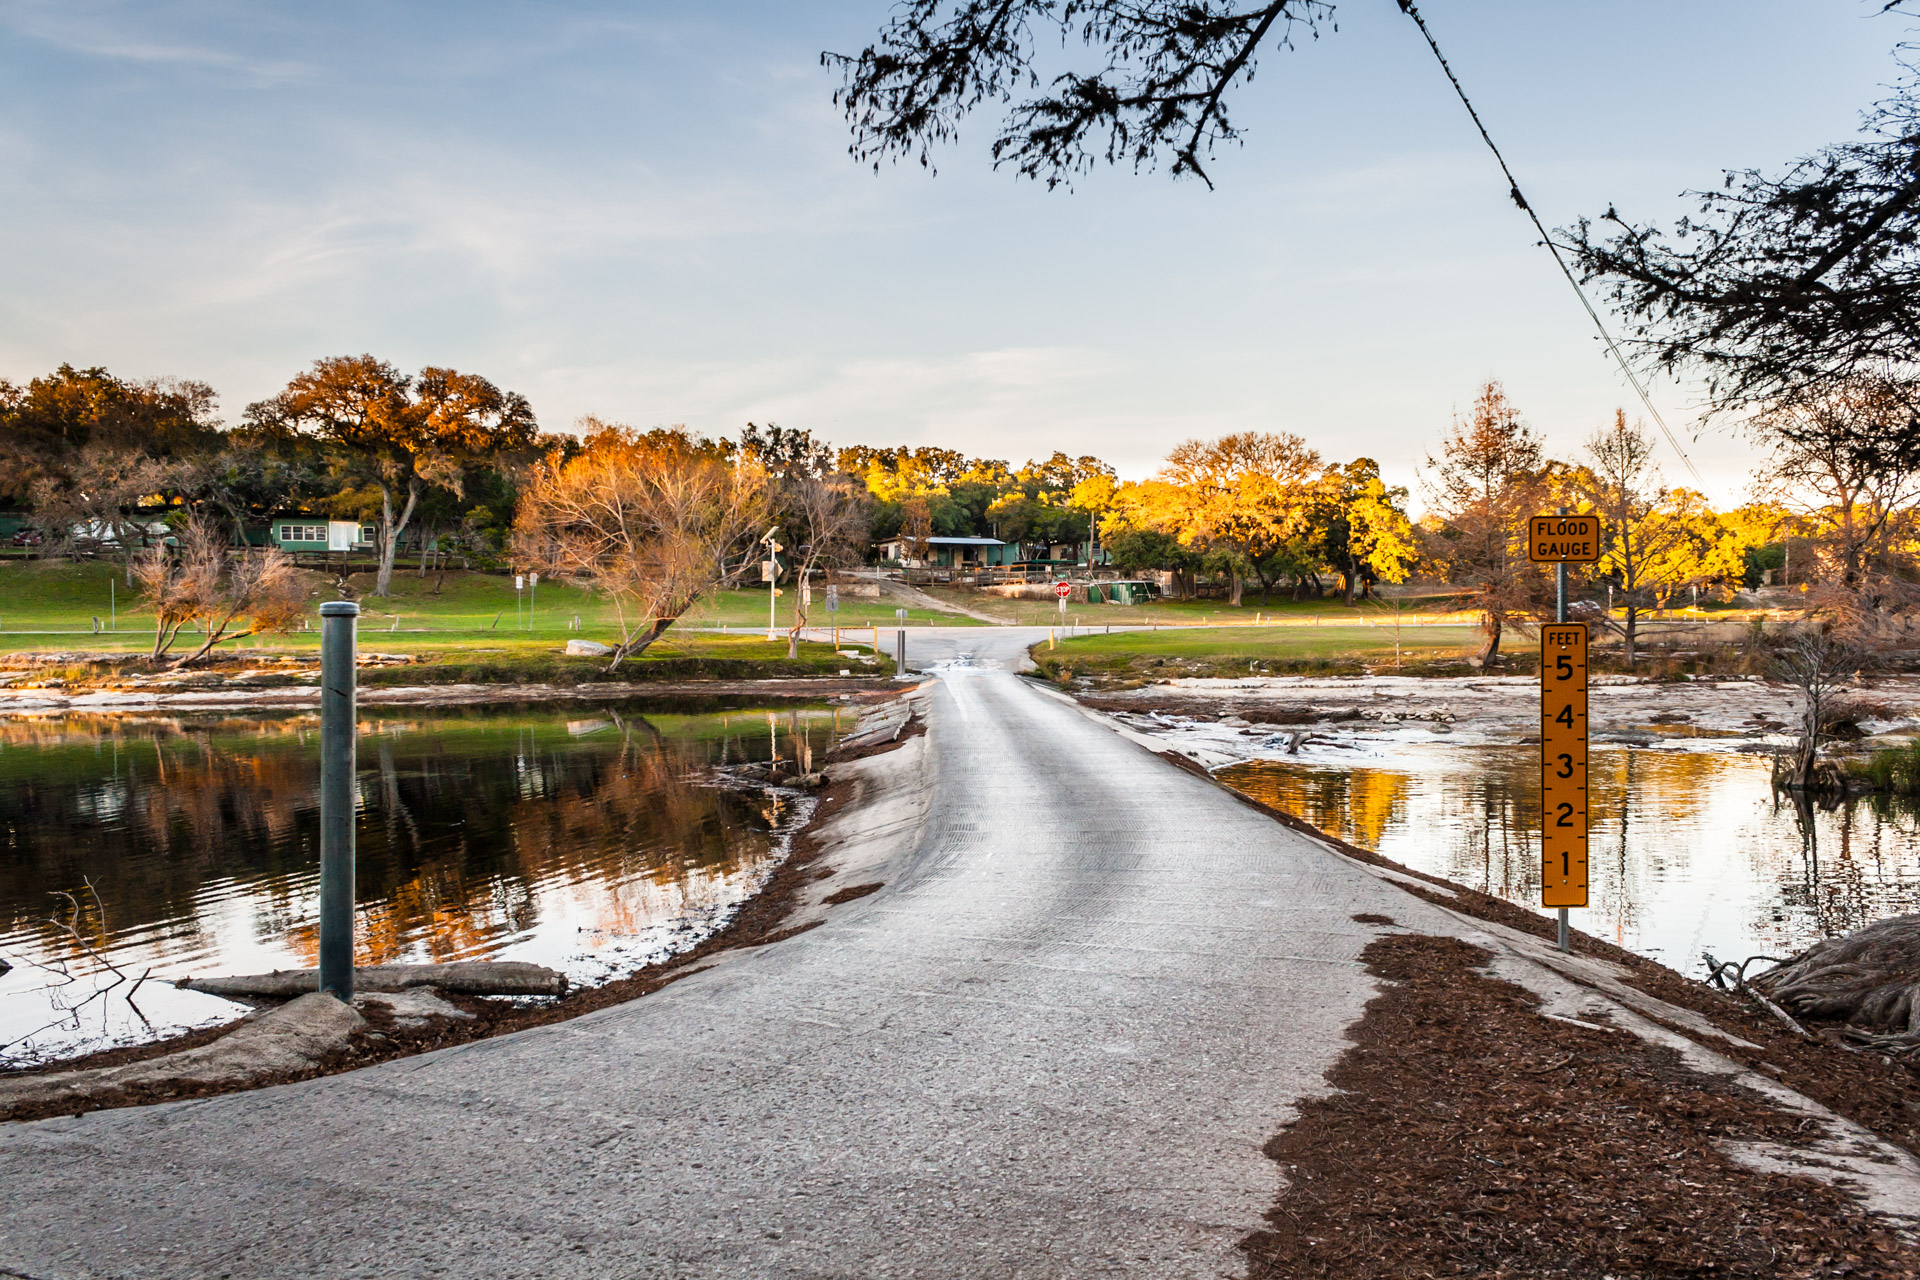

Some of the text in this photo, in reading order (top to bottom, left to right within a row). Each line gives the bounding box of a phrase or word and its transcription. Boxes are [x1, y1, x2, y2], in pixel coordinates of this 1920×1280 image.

[1538, 522, 1588, 535] FLOOD
[1538, 542, 1590, 555] GAUGE
[1549, 632, 1580, 645] FEET
[1556, 655, 1573, 681] 5
[1555, 704, 1574, 729] 4
[1556, 753, 1573, 778] 3
[1556, 802, 1573, 827] 2
[1561, 851, 1569, 876] 1
